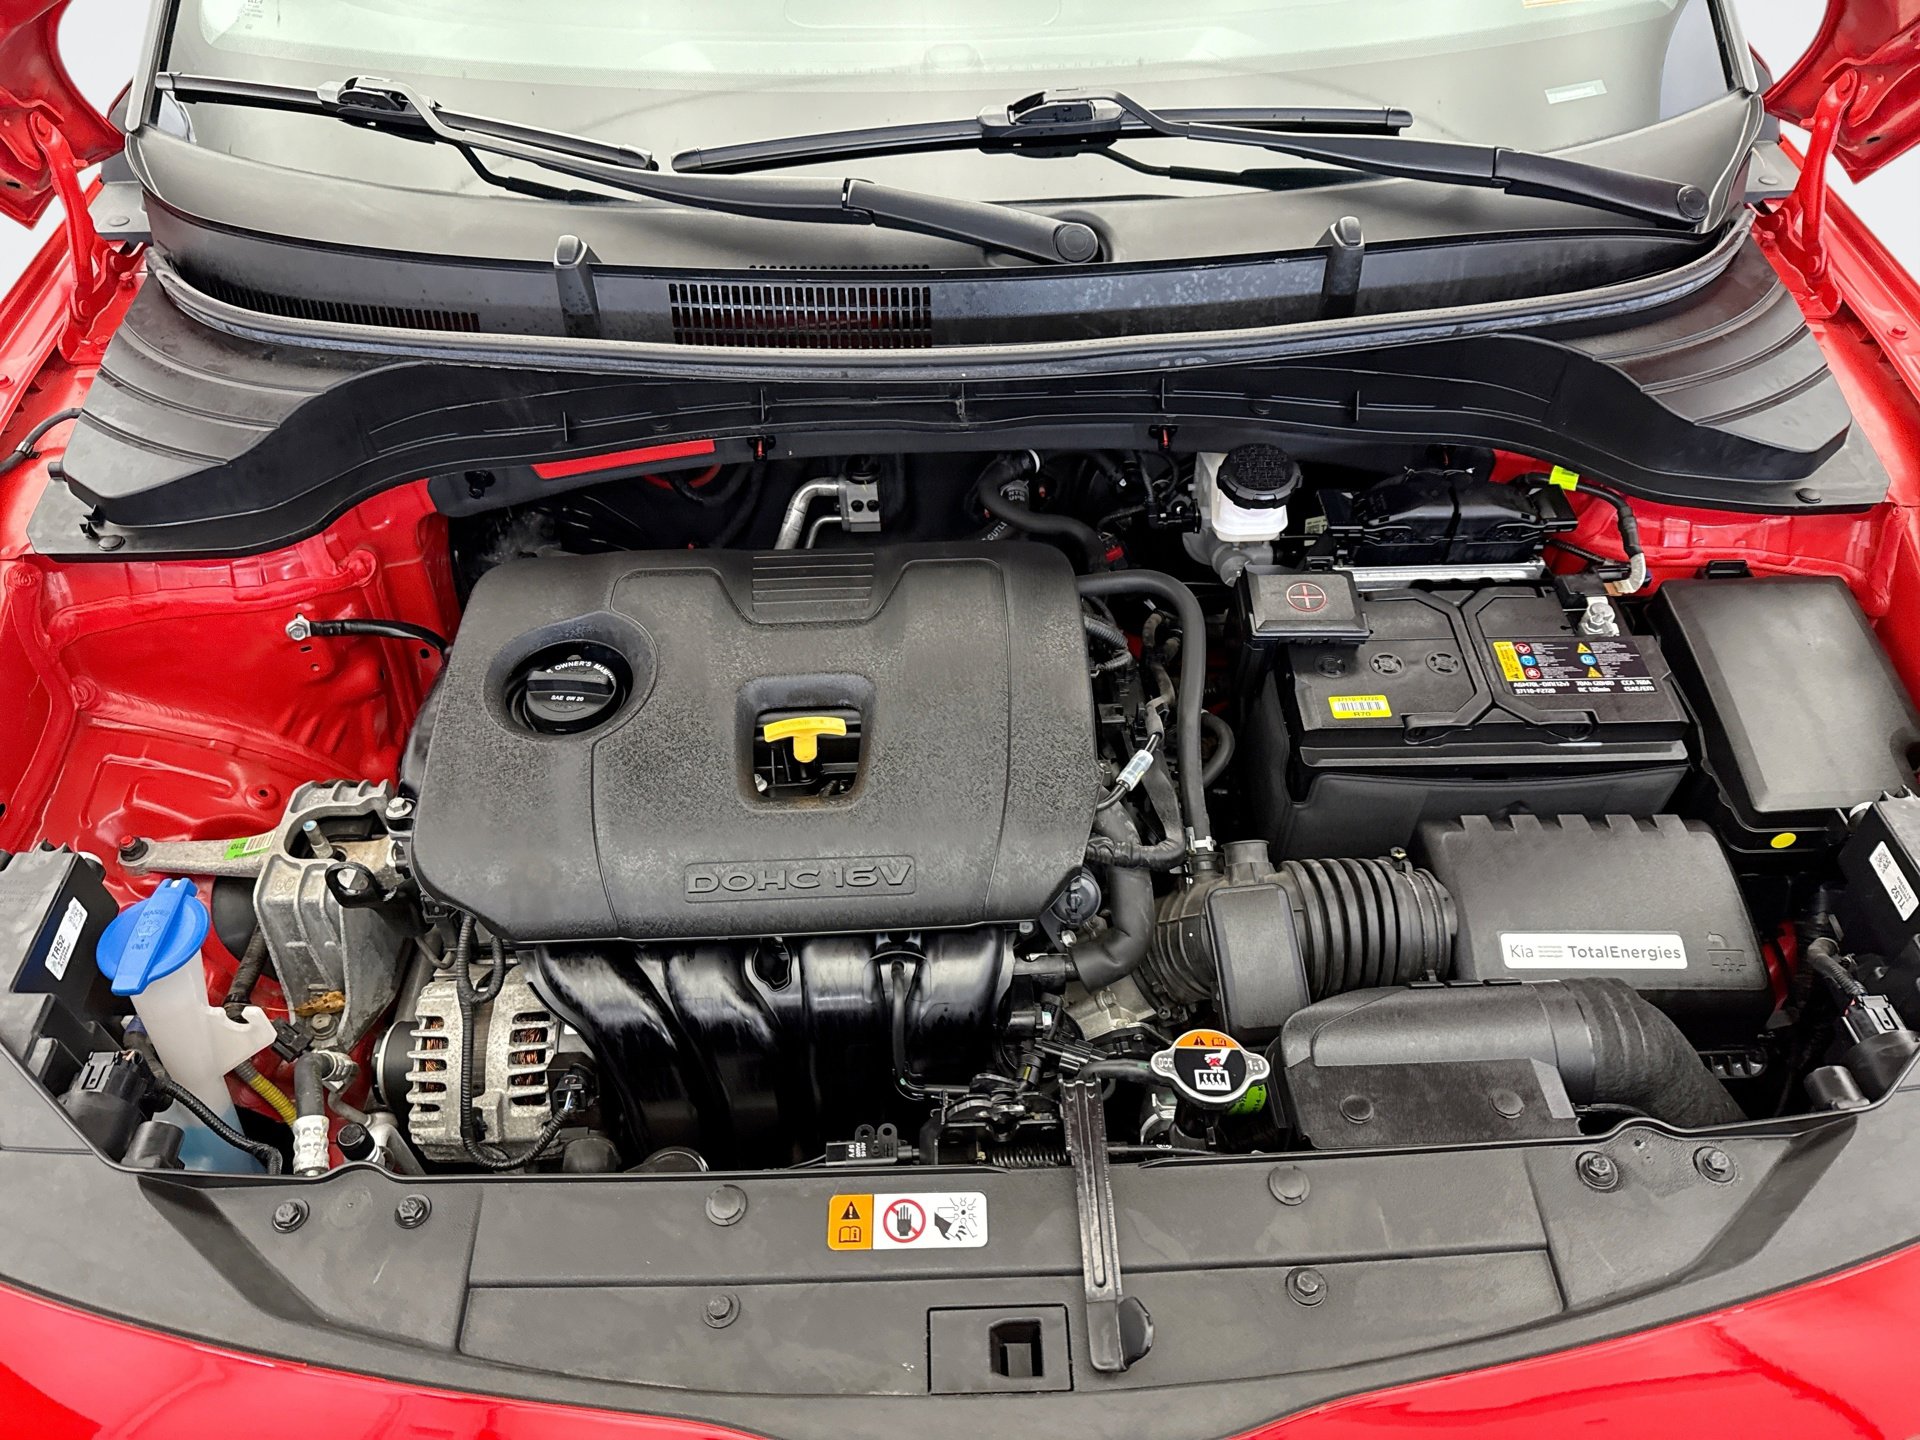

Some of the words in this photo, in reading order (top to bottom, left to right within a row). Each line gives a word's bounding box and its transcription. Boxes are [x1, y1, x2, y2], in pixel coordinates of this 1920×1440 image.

[555, 661, 592, 671] OWNER'S
[688, 869, 821, 894] DOHC
[834, 865, 911, 889] 16V
[1890, 885, 1906, 911] TL52
[51, 934, 67, 961] TR52
[1509, 944, 1534, 958] Kia
[1567, 945, 1681, 961] TotalEnergies
